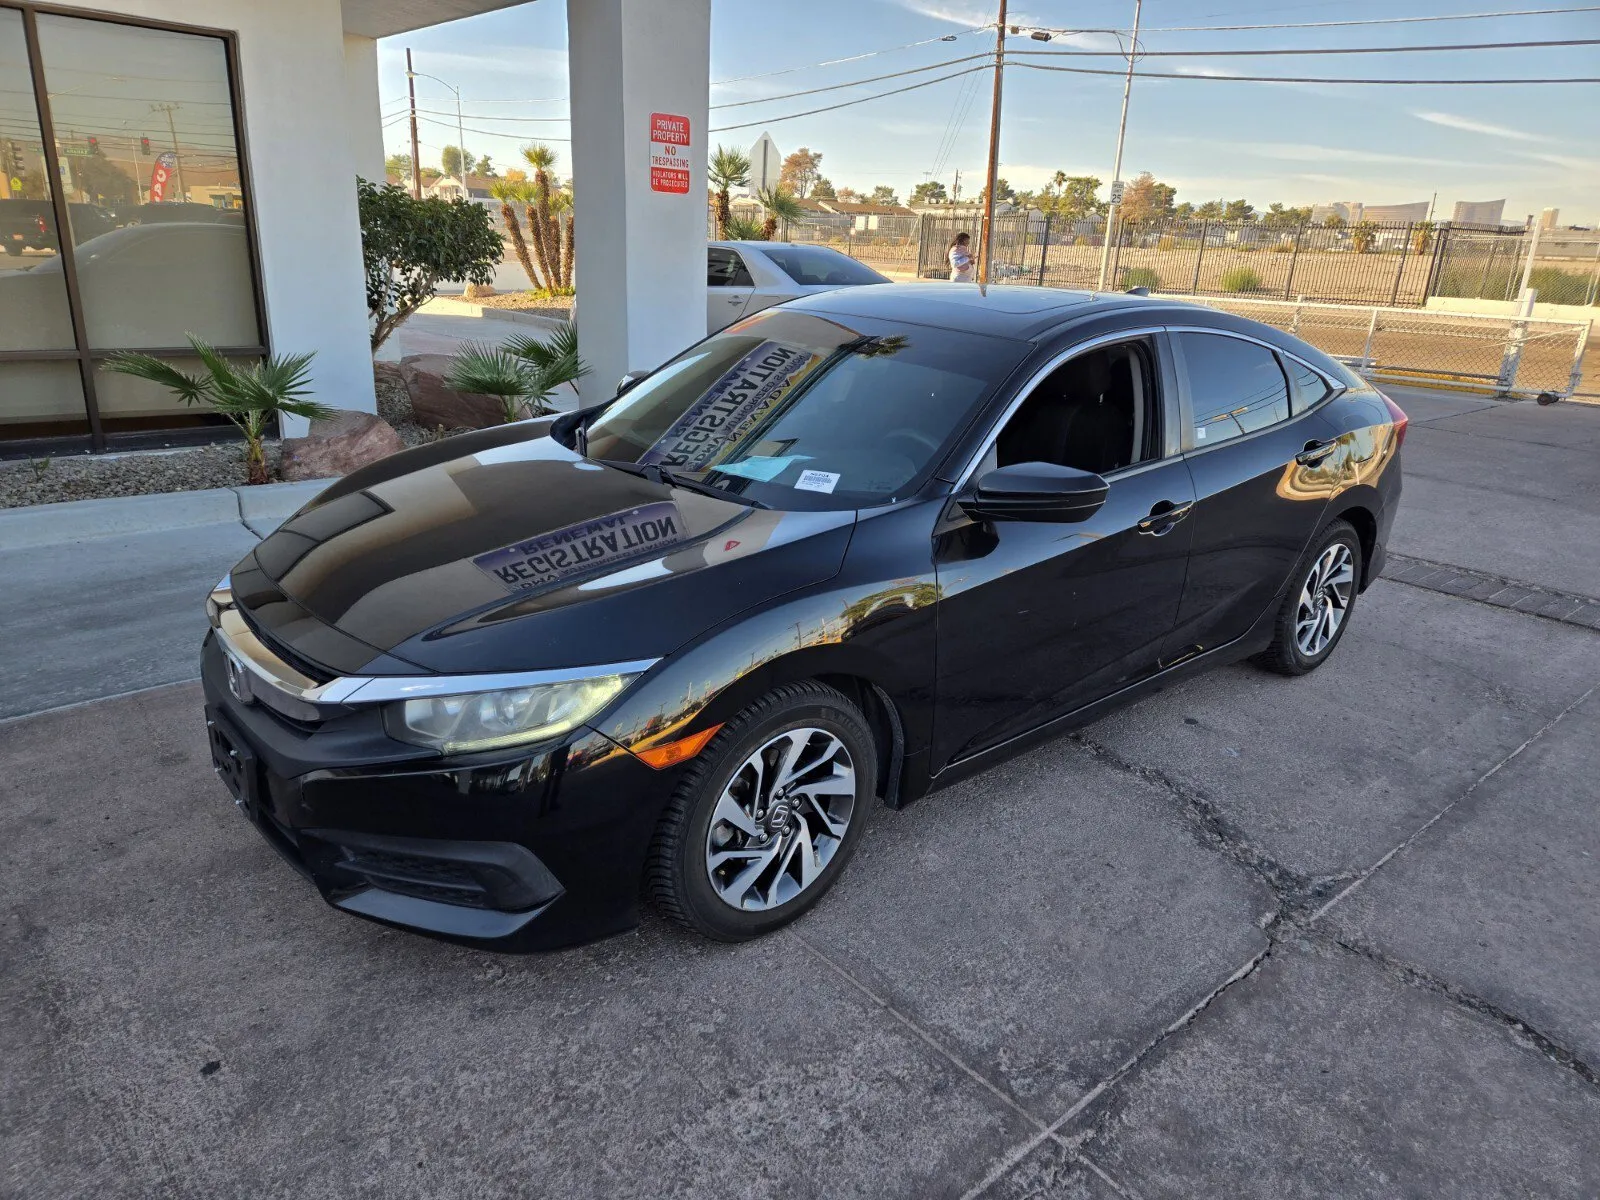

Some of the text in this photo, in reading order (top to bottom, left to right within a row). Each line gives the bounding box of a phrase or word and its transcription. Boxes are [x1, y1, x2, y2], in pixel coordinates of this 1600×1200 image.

[657, 120, 684, 132] PRIVATE
[653, 130, 687, 143] PROPERTY
[665, 145, 676, 156] NO
[652, 156, 688, 168] TRESPASSING
[653, 170, 676, 180] VIOLATORS
[653, 178, 687, 188] BE PROSECUTED
[1111, 193, 1122, 204] 25
